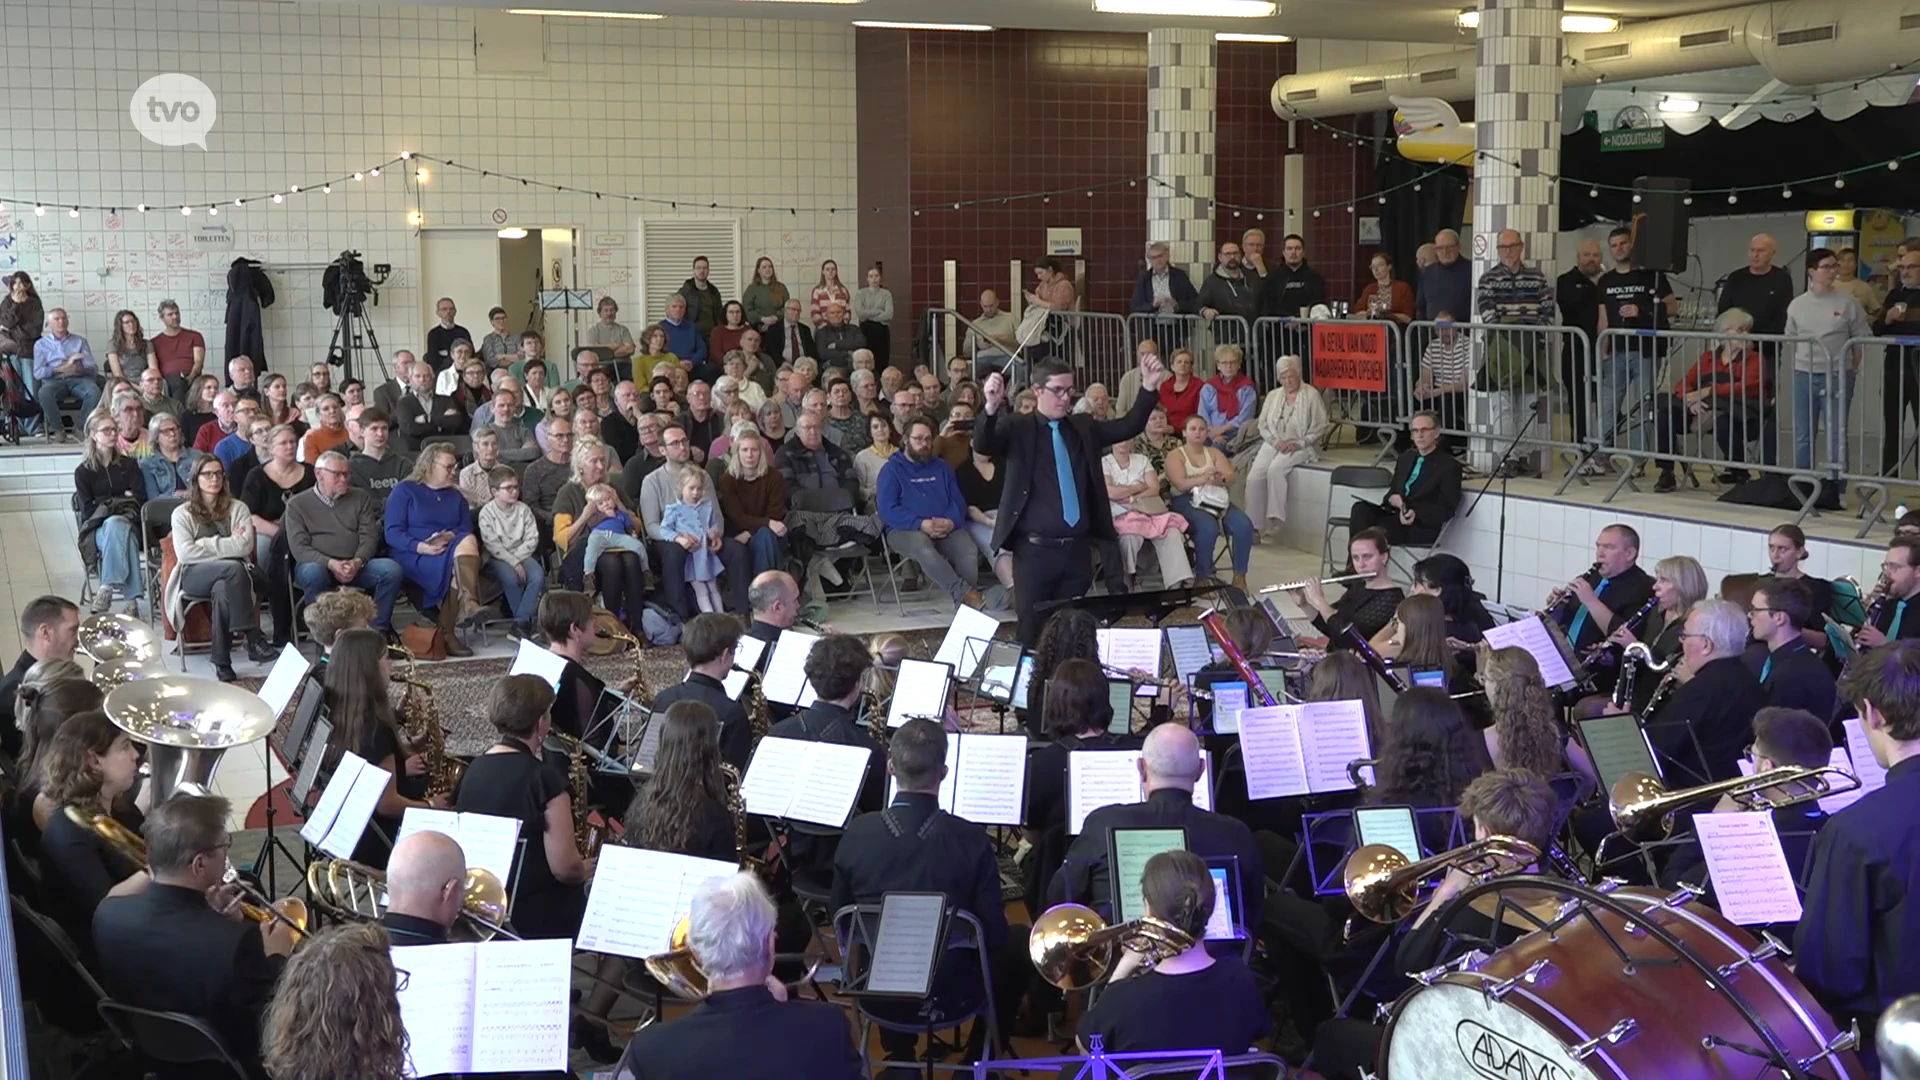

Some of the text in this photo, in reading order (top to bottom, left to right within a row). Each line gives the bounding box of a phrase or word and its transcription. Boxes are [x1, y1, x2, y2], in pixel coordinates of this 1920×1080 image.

[1611, 131, 1663, 146] NOODUITGANG
[193, 235, 231, 243] TOILETTEN
[1606, 285, 1645, 295] MOLTENI
[1327, 332, 1345, 353] GEVAL
